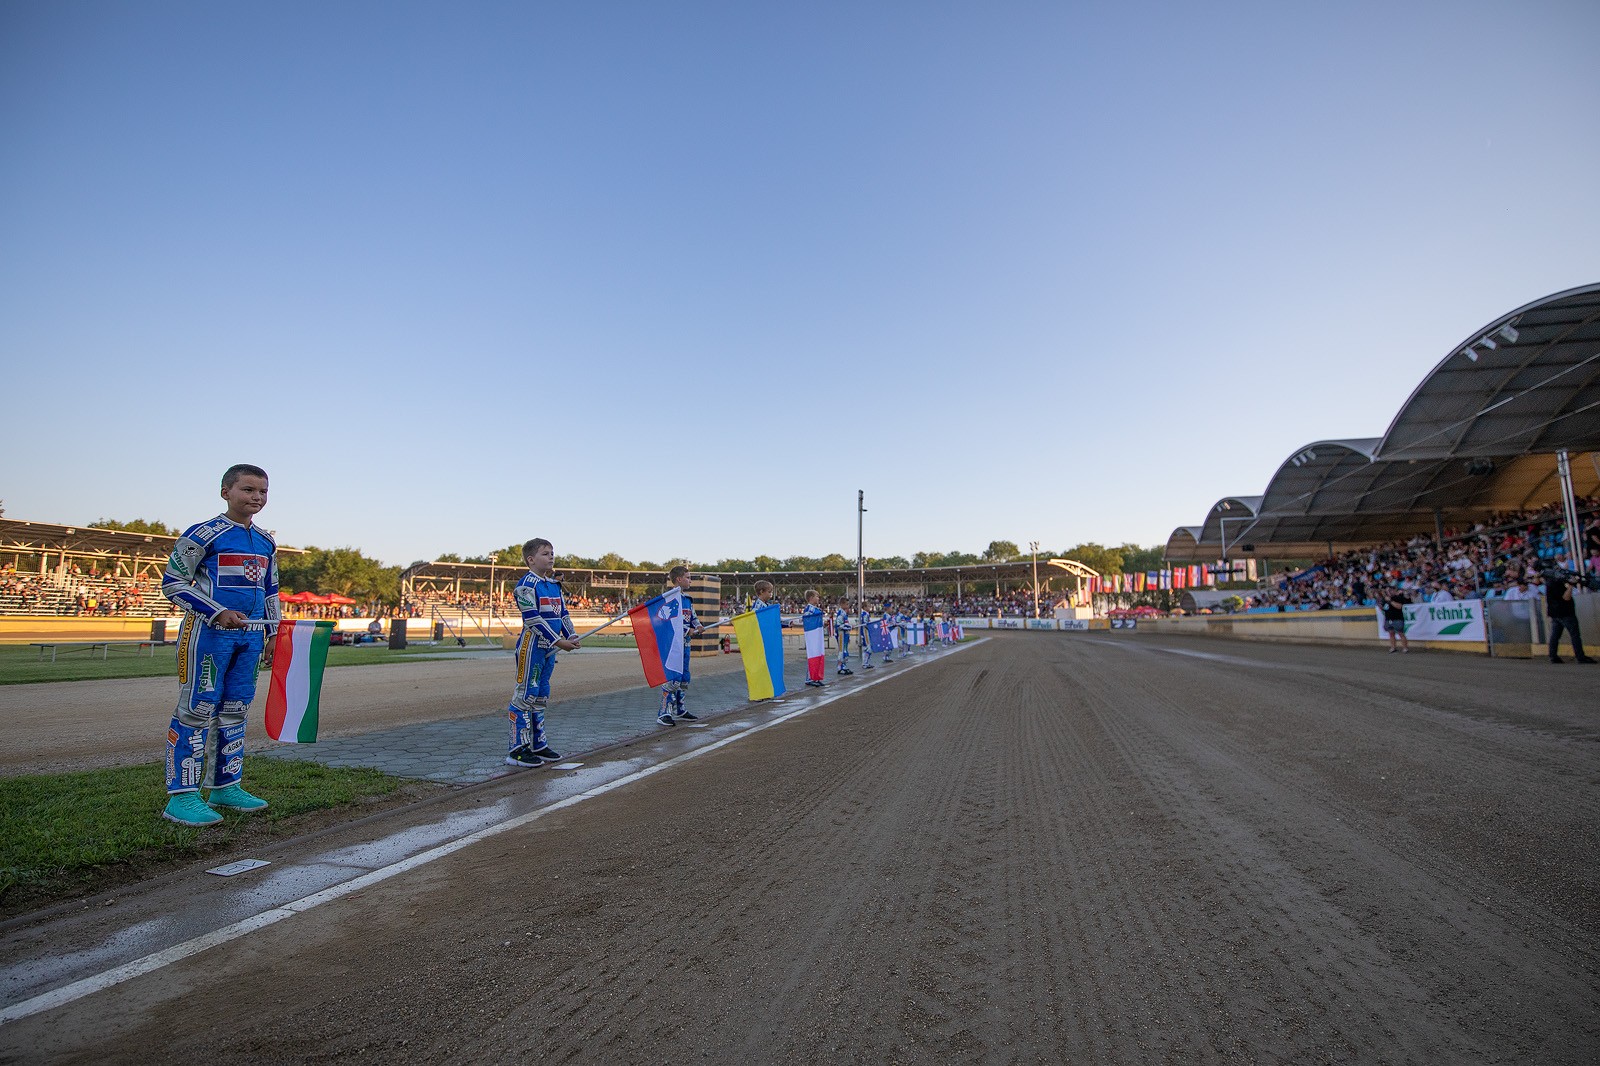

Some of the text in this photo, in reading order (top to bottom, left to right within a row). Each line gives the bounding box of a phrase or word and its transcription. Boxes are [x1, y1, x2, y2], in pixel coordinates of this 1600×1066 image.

[1429, 603, 1473, 620] Tehnix
[197, 654, 212, 693] Tehnix
[226, 726, 243, 738] Allianz
